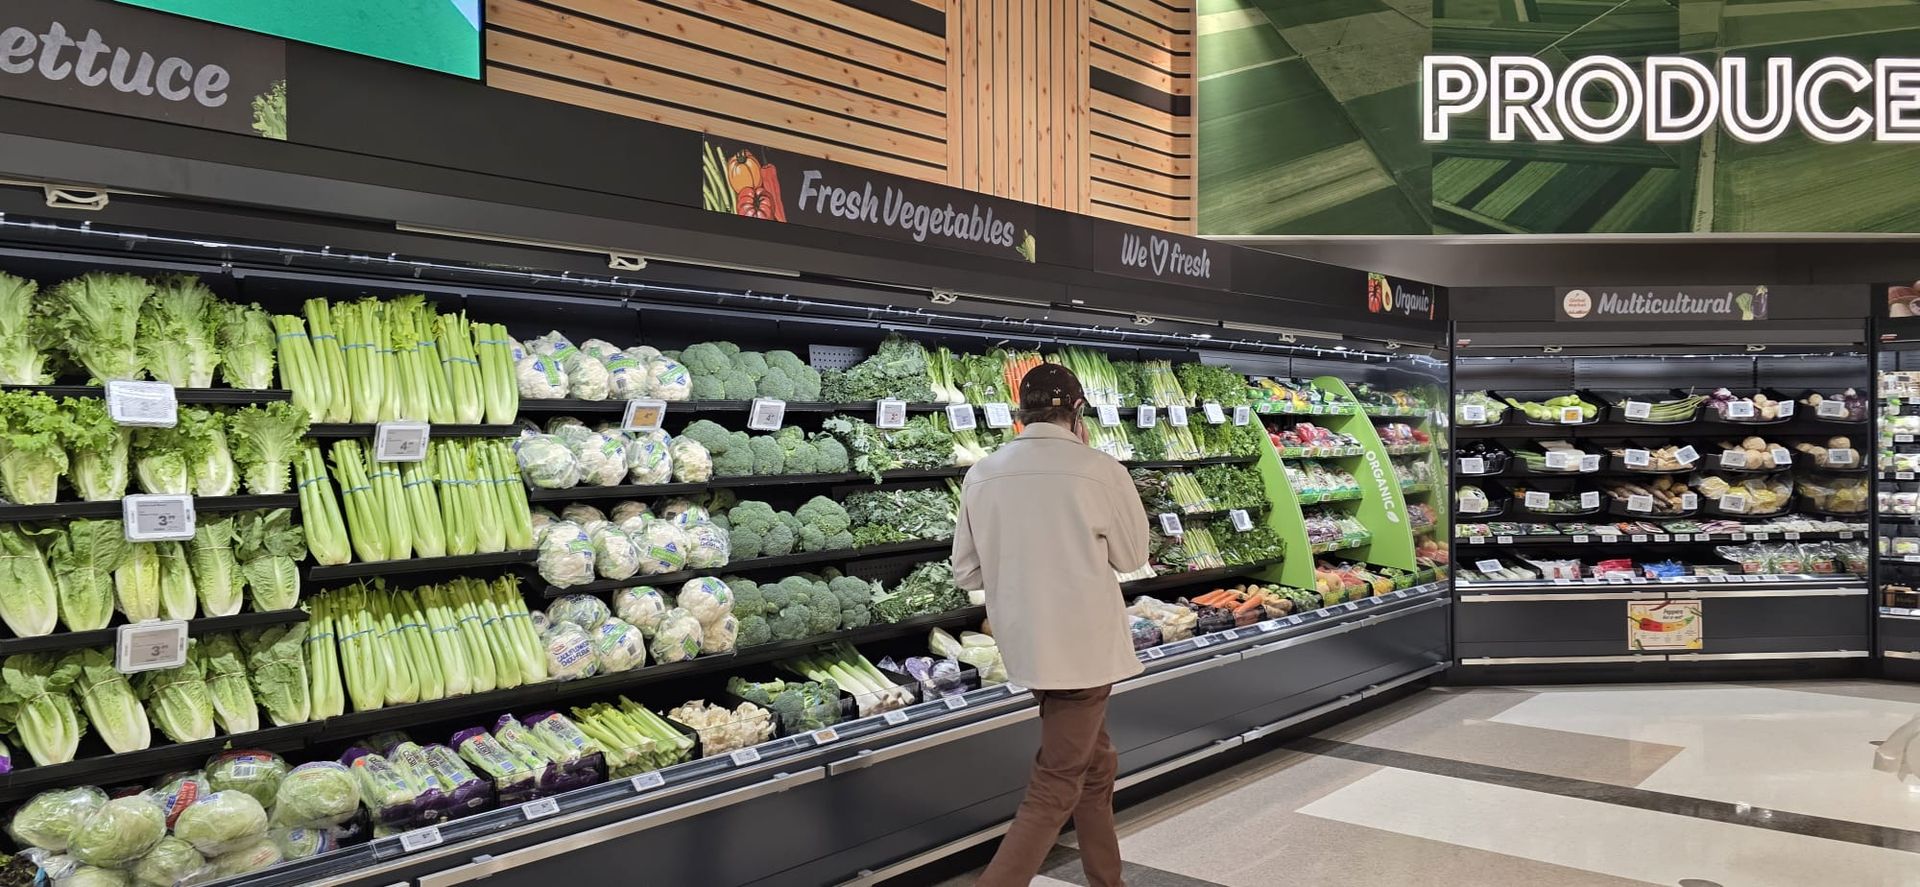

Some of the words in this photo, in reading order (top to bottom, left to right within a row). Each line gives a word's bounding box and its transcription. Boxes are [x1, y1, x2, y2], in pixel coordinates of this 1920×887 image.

[1423, 55, 1920, 142] PRODUCE
[798, 169, 878, 223] Fresh
[882, 186, 1015, 248] Vegetables
[1121, 232, 1148, 268] We
[1170, 242, 1211, 279] fresh
[1395, 284, 1429, 316] Organic
[1597, 292, 1733, 314] Multicultural
[1365, 450, 1395, 510] ORGANIC
